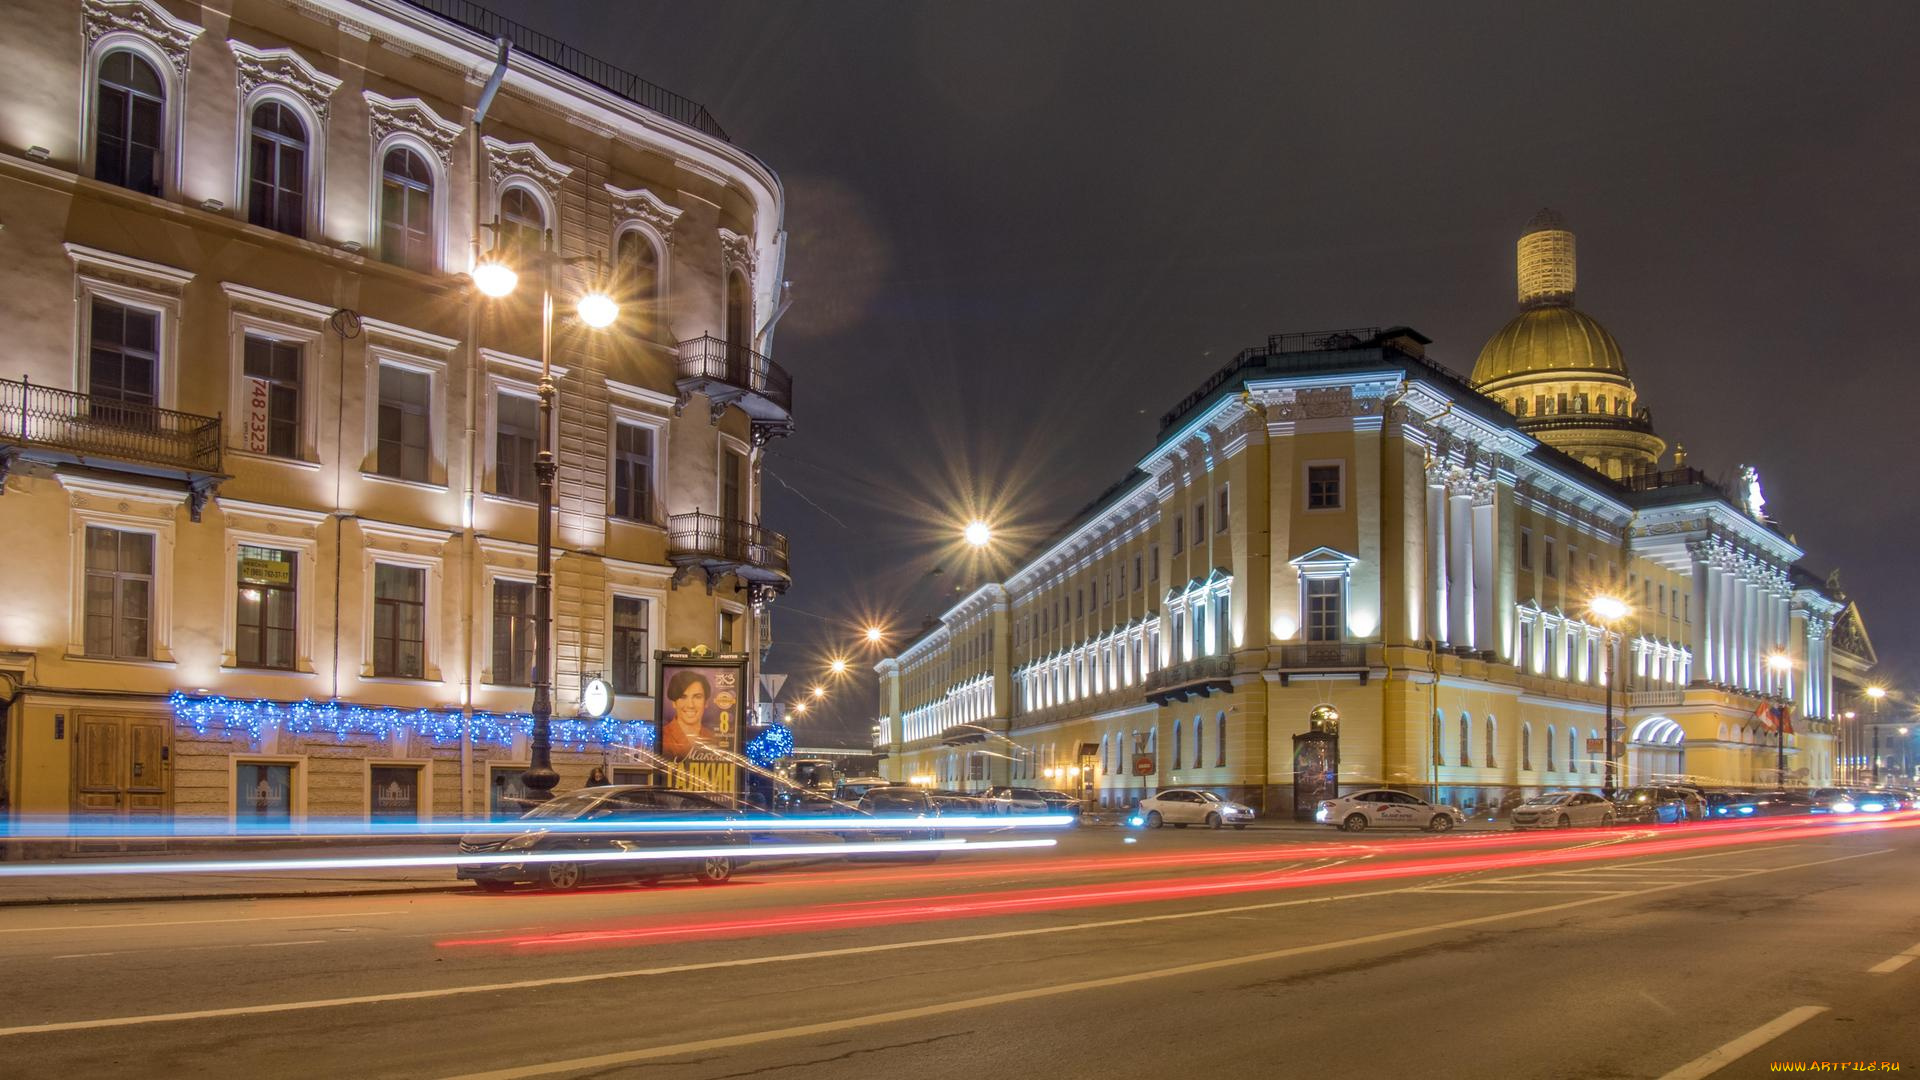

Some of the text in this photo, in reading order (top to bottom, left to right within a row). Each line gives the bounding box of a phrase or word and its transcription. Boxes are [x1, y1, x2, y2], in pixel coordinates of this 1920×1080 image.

[250, 380, 266, 453] 748 2323
[719, 711, 729, 733] 8
[667, 762, 735, 793] ГАЛКИН
